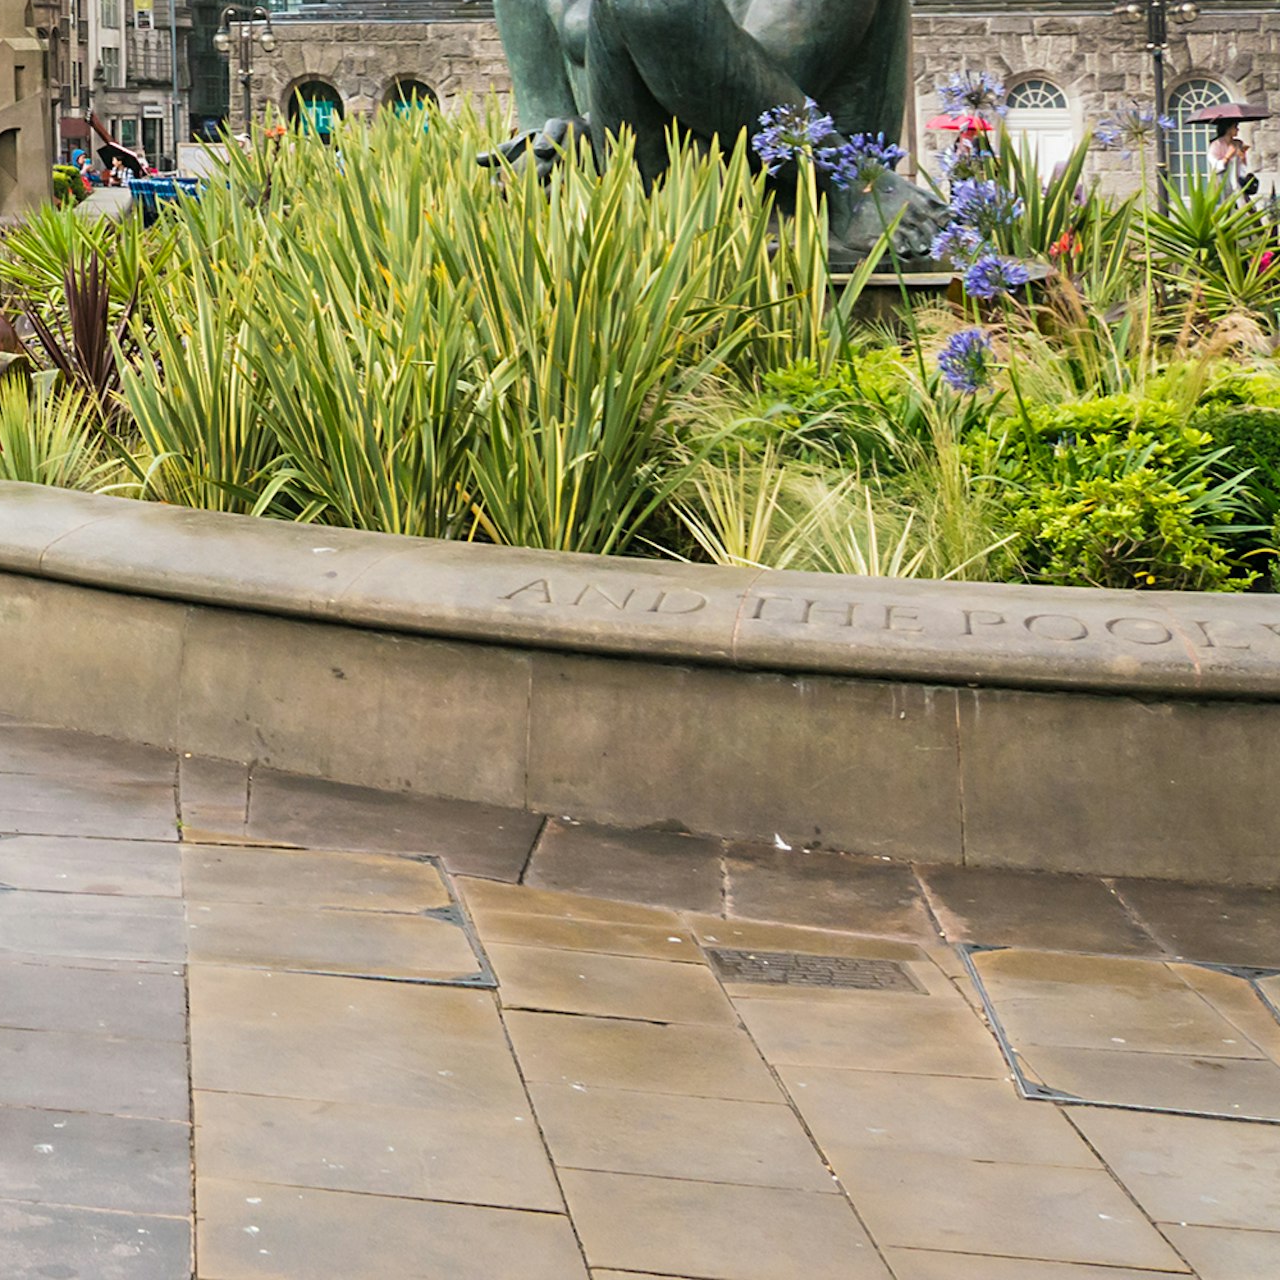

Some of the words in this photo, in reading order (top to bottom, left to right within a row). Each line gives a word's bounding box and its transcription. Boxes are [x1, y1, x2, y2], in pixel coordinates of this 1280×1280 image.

[497, 577, 708, 615] AND
[736, 593, 924, 634] THE
[961, 609, 1252, 650] POOL
